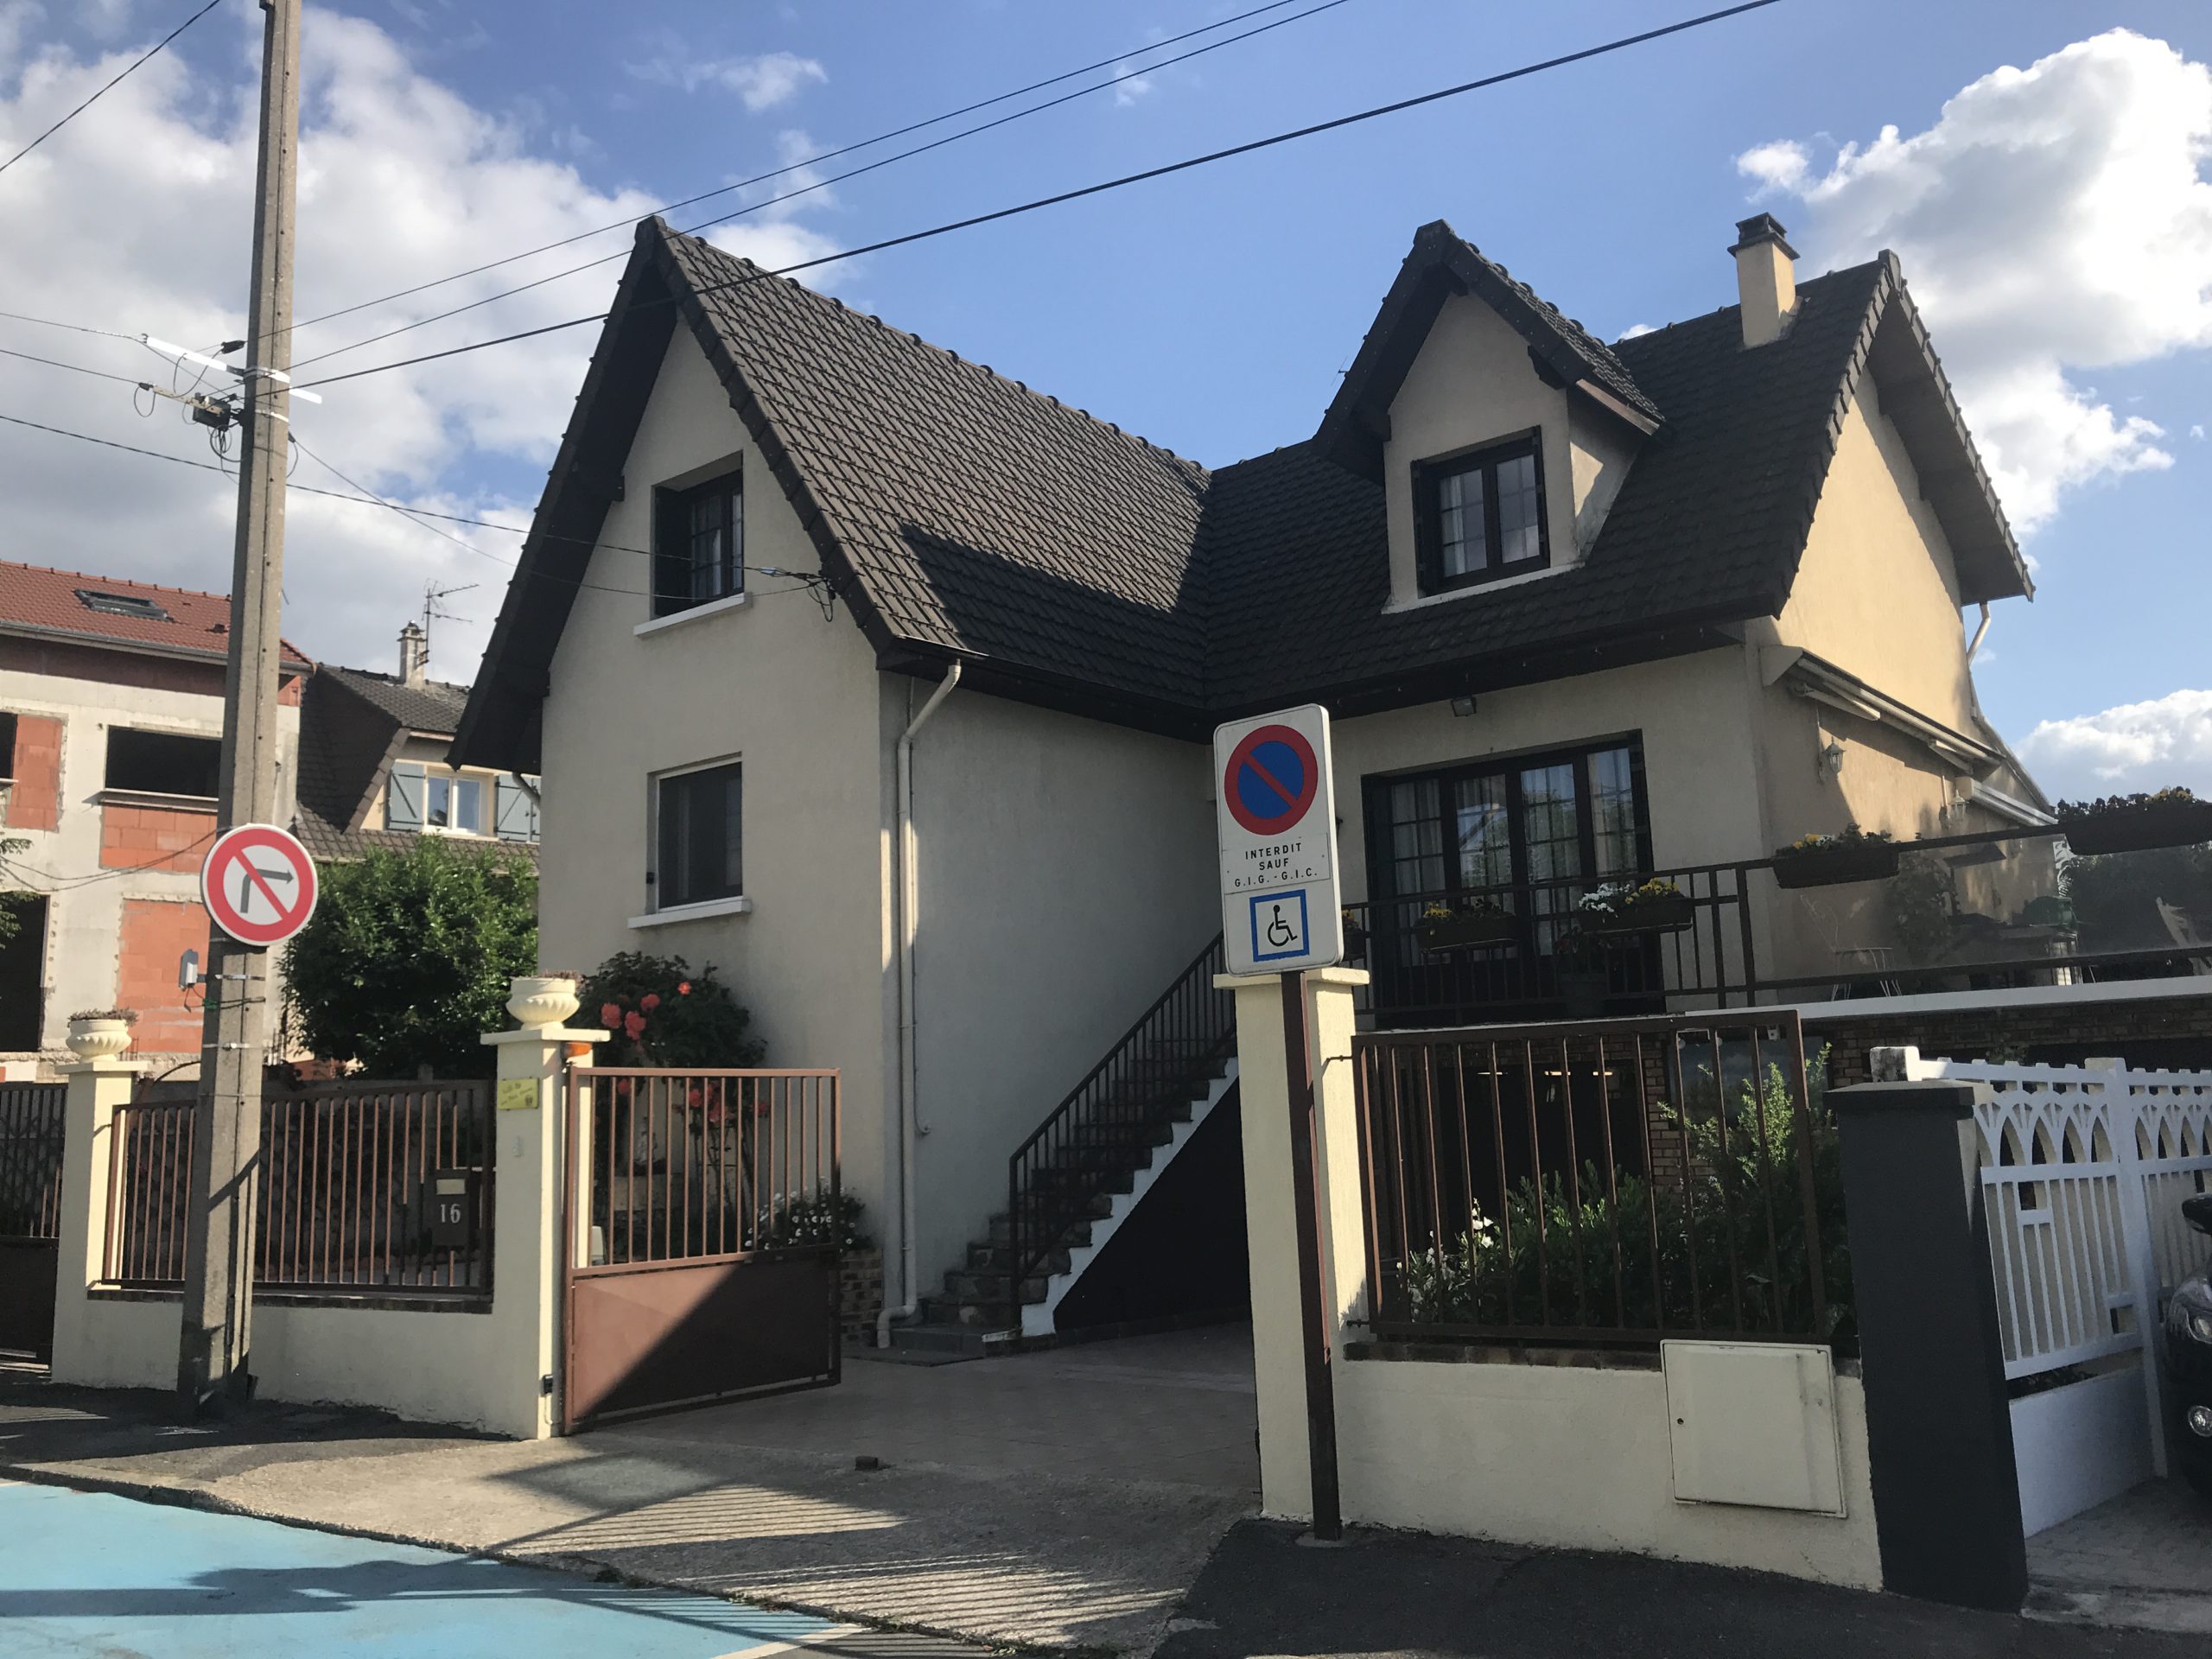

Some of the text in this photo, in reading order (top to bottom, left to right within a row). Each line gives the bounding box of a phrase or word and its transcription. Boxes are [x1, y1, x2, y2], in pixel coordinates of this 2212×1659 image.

[1245, 842, 1301, 860] INTERDIT
[1259, 858, 1289, 870] SAUF
[441, 1204, 461, 1224] 16
